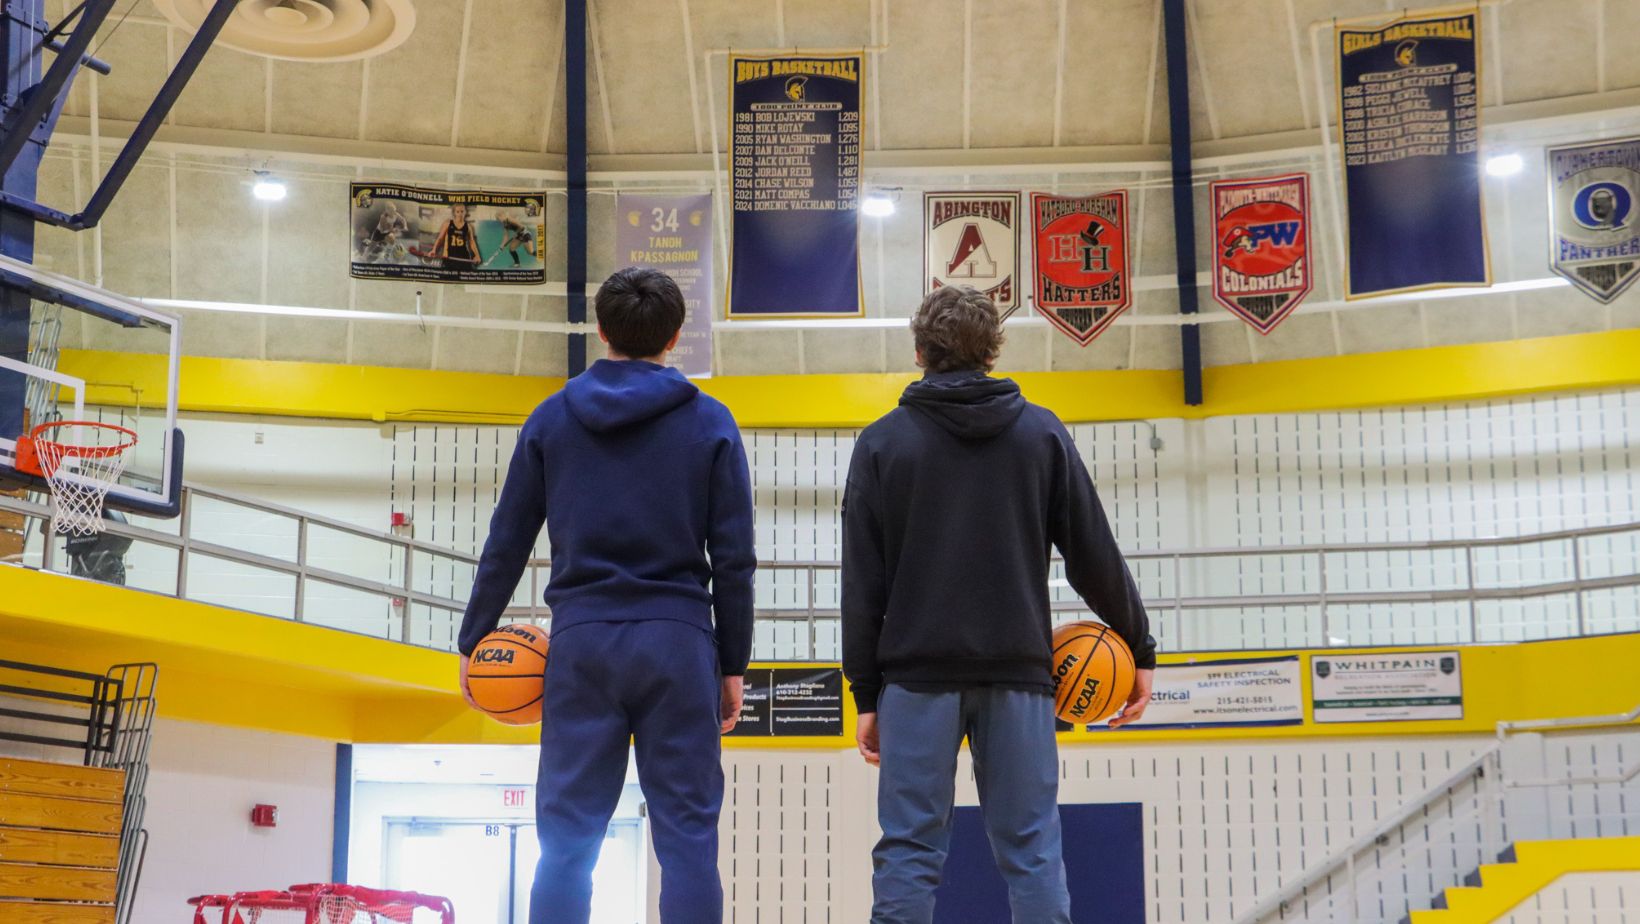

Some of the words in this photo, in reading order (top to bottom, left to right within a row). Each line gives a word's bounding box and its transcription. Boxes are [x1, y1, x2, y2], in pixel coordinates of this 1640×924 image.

[1343, 32, 1382, 55] GIRLS
[1384, 18, 1473, 42] BASKETBALL
[736, 61, 769, 83] BOYS
[772, 59, 857, 81] BASKETBALL
[735, 114, 754, 123] 1981
[755, 113, 772, 122] BOB
[735, 125, 754, 134] 1990
[755, 124, 776, 133] MIKE
[778, 123, 804, 133] ROTAY
[735, 136, 754, 145] 2005
[755, 135, 777, 144] RYAN
[780, 134, 831, 144] WASHINGTON
[735, 147, 754, 156] 2007
[755, 146, 772, 155] DAN
[754, 157, 777, 166] JACK
[779, 157, 810, 166] O'NEILL
[735, 169, 752, 178] 2012
[754, 168, 788, 177] JORDAN
[790, 168, 811, 177] REED
[735, 180, 752, 189] 2014
[754, 179, 782, 188] CHASE
[783, 179, 814, 188] WILSON
[375, 187, 400, 198] KATIE
[401, 190, 443, 202] O'DONNELL
[448, 194, 465, 203] WHS
[467, 194, 489, 203] FIELD
[491, 196, 521, 204] HOCKEY
[735, 191, 752, 200] 2021
[754, 190, 776, 199] MATT
[778, 190, 810, 199] COMPAS
[735, 202, 752, 211] 2024
[754, 201, 788, 210] DOMENIC
[1572, 181, 1632, 232] Q
[651, 207, 680, 233] 34
[932, 200, 1011, 229] ABINGTON
[1041, 199, 1119, 231] HATBORO-HORSHAM
[1247, 221, 1300, 248] PW
[648, 237, 682, 249] TANOH
[946, 222, 997, 278] A
[630, 250, 699, 264] KPASSAGNON
[1222, 257, 1303, 292] COLONIALS
[1042, 273, 1121, 303] HATTERS
[473, 649, 516, 664] NCAA
[1335, 660, 1436, 670] WHITPAIN
[1224, 670, 1280, 678] ELECTRICAL
[1197, 680, 1232, 688] SAFETY
[1234, 678, 1292, 687] INSPECTION
[1070, 678, 1102, 718] NCAA
[1151, 690, 1190, 701] ctrical
[504, 790, 526, 806] EXIT
[485, 824, 500, 836] B8
